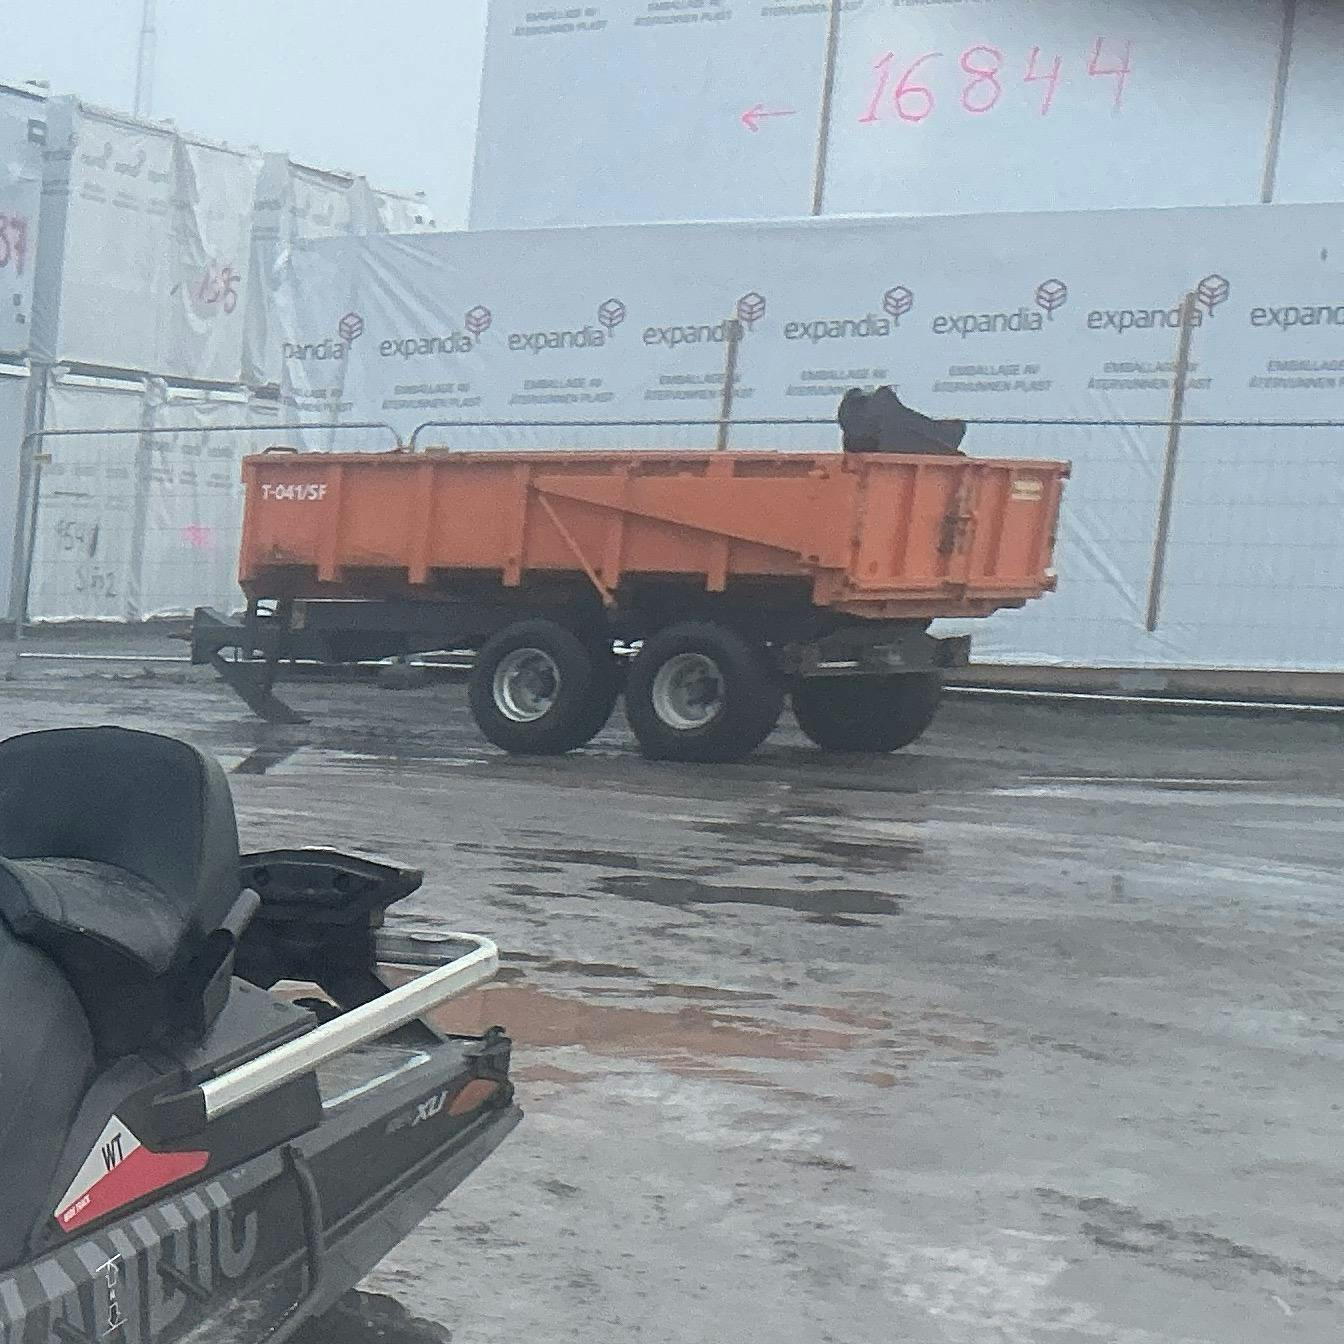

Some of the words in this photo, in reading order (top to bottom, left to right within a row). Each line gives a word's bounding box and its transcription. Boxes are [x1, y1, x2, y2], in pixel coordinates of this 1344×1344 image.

[642, 318, 745, 349] expand
[784, 313, 891, 344] expandia
[932, 306, 1044, 338] expandia
[1087, 303, 1203, 335] expanda
[379, 329, 474, 360] expandia
[508, 324, 607, 355] expandia
[100, 1131, 122, 1173] WT
